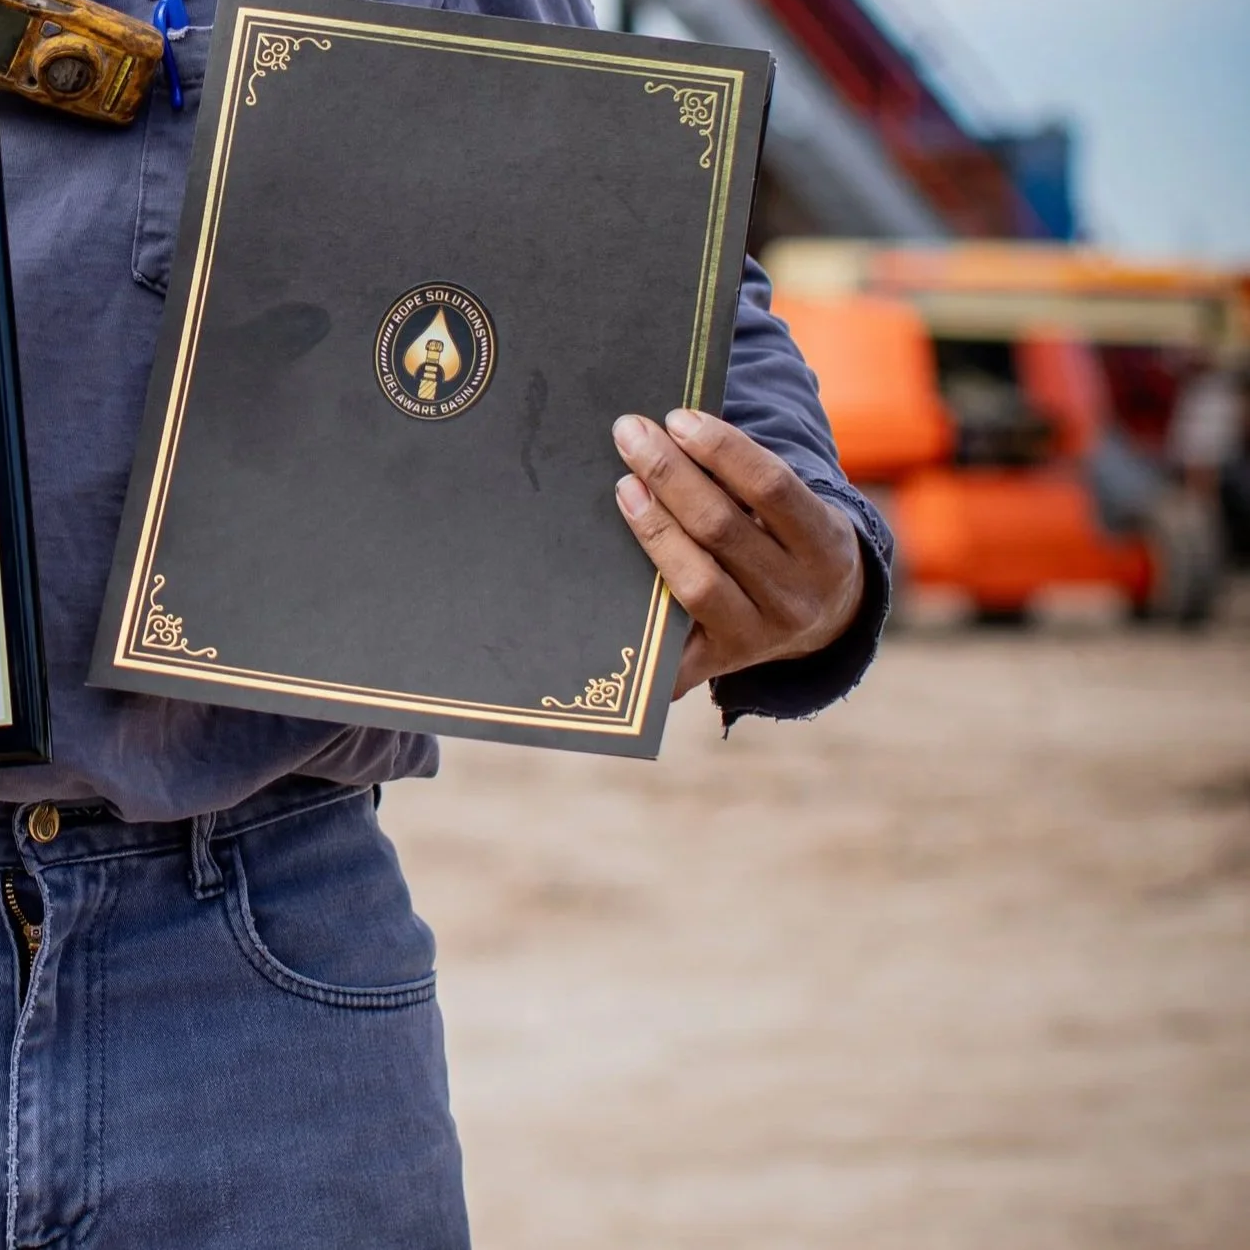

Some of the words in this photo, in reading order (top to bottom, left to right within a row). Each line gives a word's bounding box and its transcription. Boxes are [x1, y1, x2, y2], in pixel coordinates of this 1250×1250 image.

[392, 294, 424, 324] ROPE
[425, 289, 486, 338] SOLUTIONS
[383, 373, 438, 416] DELAWARE
[440, 386, 475, 414] BASIN
